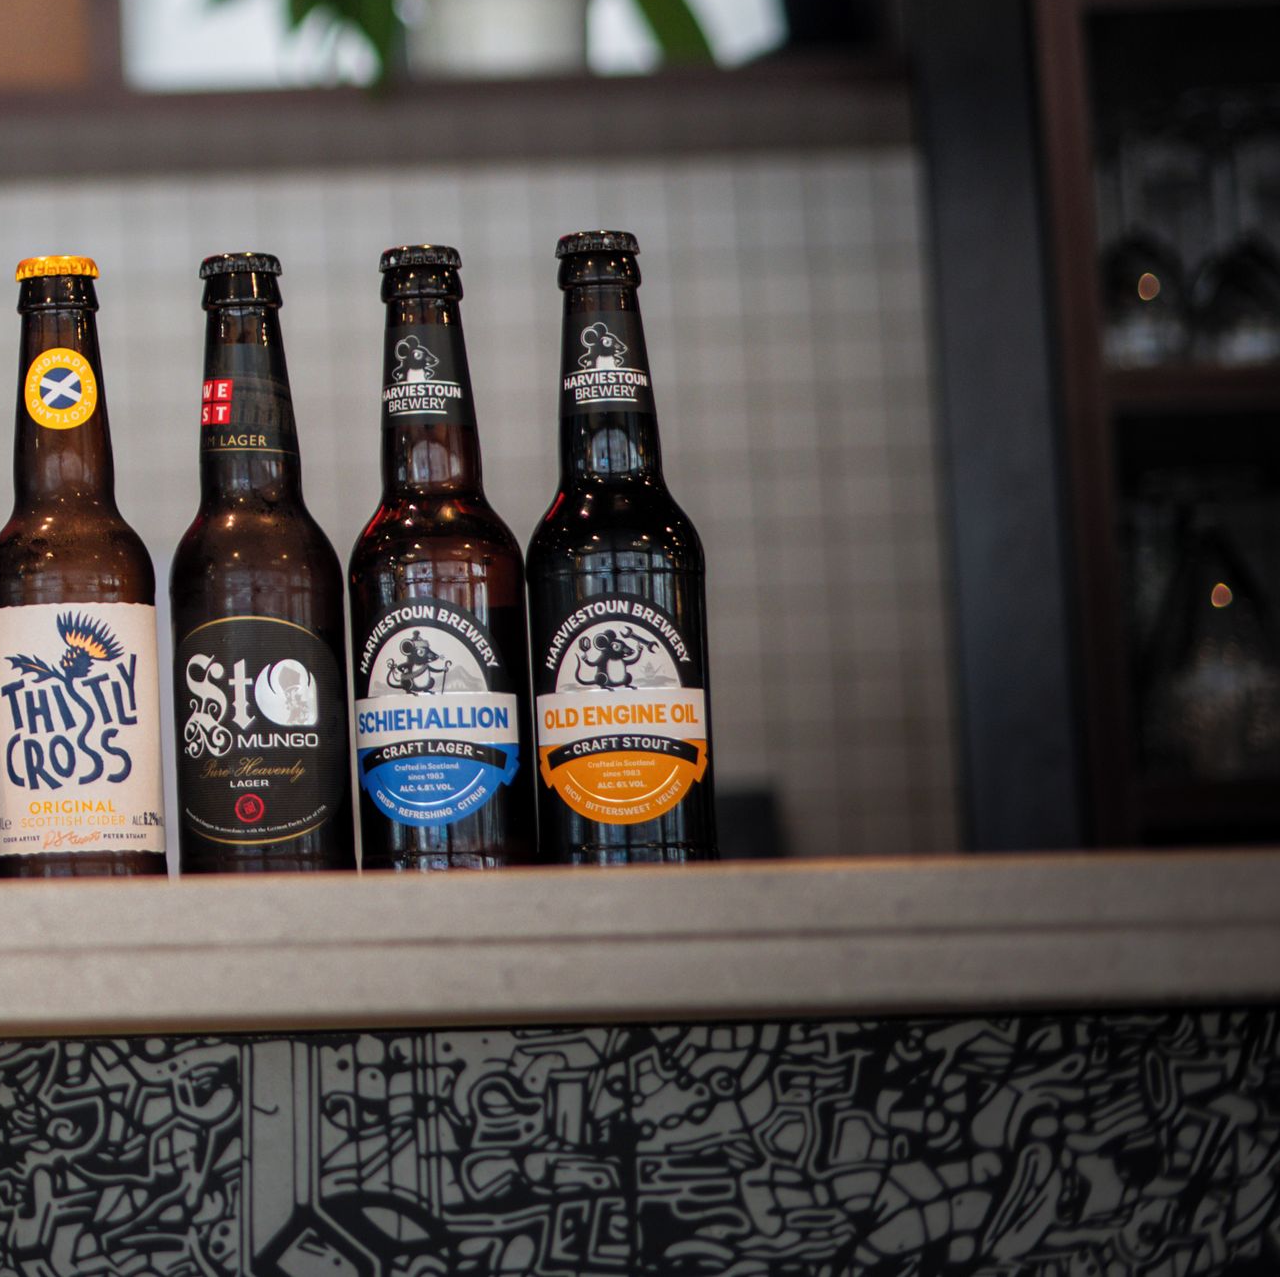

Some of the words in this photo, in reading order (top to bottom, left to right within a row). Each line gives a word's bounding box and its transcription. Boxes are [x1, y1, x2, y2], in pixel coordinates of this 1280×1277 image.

[563, 371, 648, 391] HARVIESTOUN
[575, 385, 636, 400] BREWERY
[388, 397, 446, 413] BREWERY
[220, 434, 267, 446] LAGER
[360, 605, 435, 675] HARVIESTOUN
[437, 608, 500, 668] BREWERY
[545, 600, 629, 671] HARVIESTOUN
[631, 603, 692, 663] BREWERY
[1, 653, 137, 734] THISTLY
[358, 706, 509, 734] SCHIEHALLION
[544, 707, 579, 730] OLD
[583, 703, 667, 726] ENGINE
[670, 703, 699, 724] OIL
[237, 733, 319, 748] MUNGO
[573, 737, 618, 755] CRAFT
[622, 737, 671, 751] STOUT
[6, 728, 132, 790] CROSS
[382, 742, 424, 759] CRAFT
[427, 741, 473, 756] LAGER
[234, 756, 306, 783] Heavenly
[229, 779, 270, 788] LAGER
[399, 784, 416, 793] ALC.
[436, 783, 455, 791] VOL.
[597, 781, 615, 789] ALC.
[628, 780, 647, 788] VOL.
[376, 789, 395, 810] CRISP
[398, 807, 453, 819] REFRESHING
[457, 785, 487, 811] CITRUS
[564, 783, 582, 803] RICH
[585, 801, 651, 816] BITTERSWEET
[656, 779, 683, 806] VELVET
[29, 799, 116, 815] ORIGINAL
[21, 816, 84, 829] SCOTTISH
[92, 814, 127, 827] CIDER
